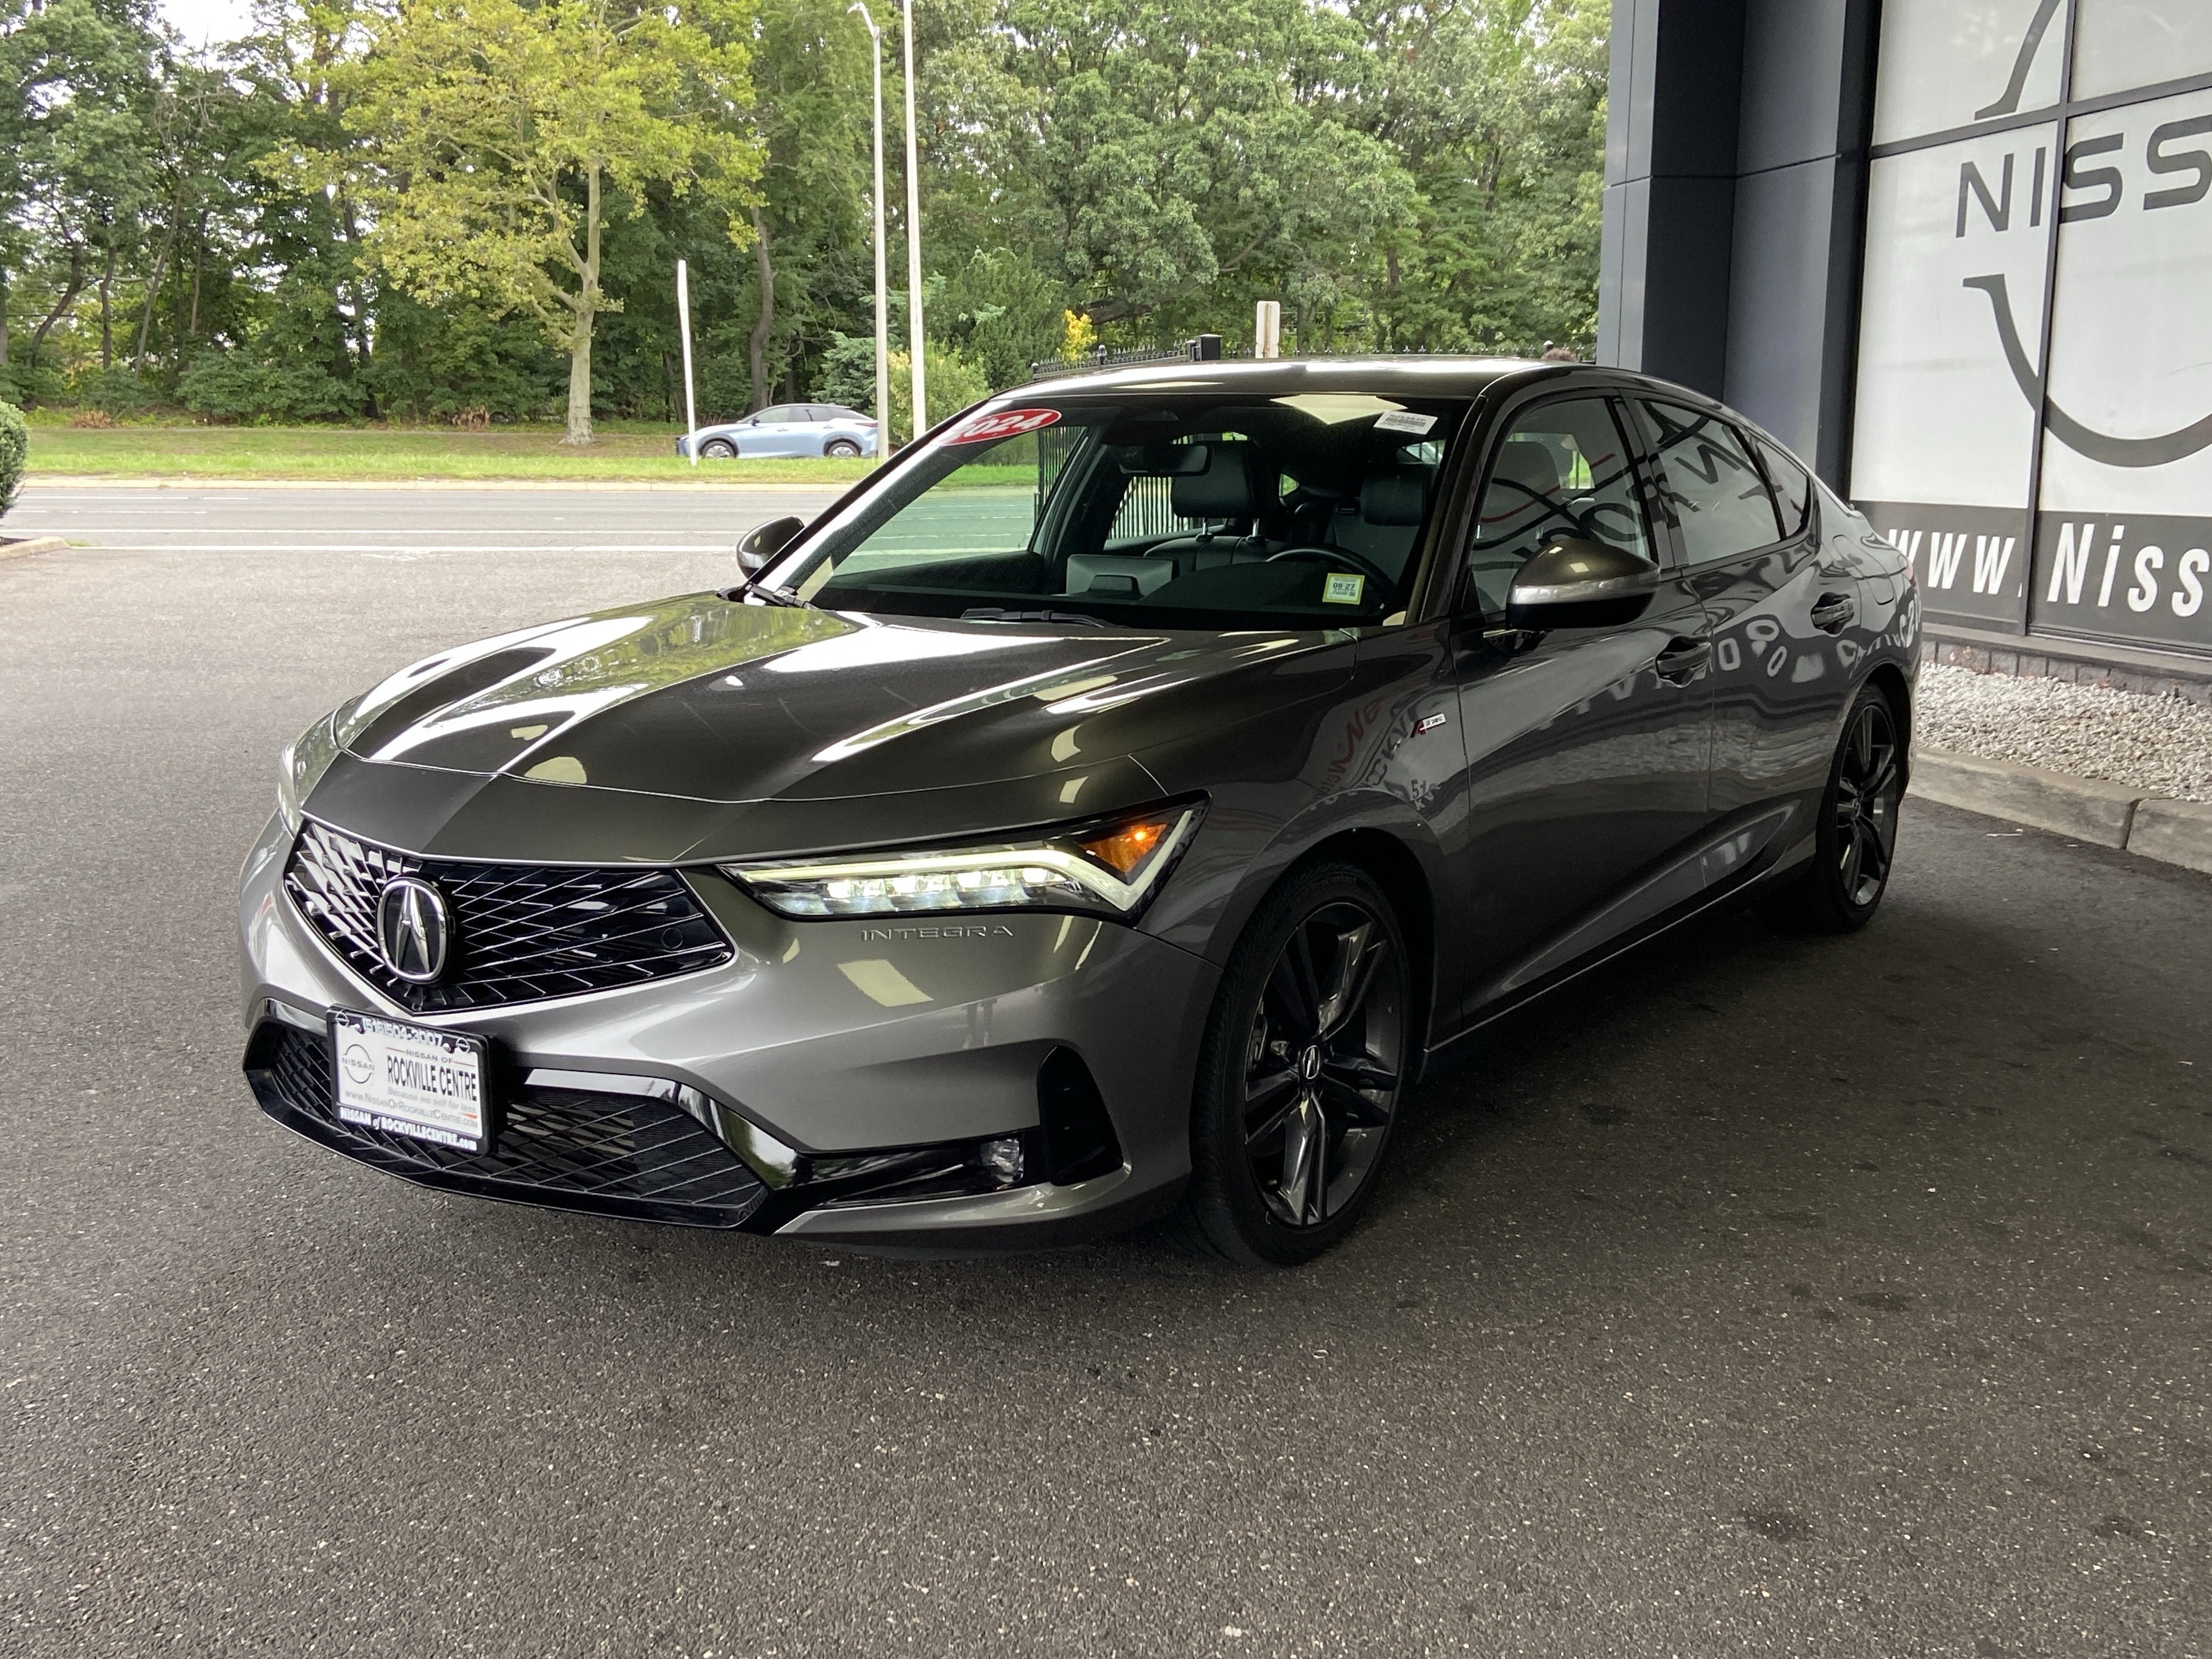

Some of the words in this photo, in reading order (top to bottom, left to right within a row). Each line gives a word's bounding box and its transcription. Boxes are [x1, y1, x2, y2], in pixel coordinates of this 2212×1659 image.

[1955, 115, 2212, 238] NISS
[862, 926, 1014, 941] INTEGRA
[342, 1057, 375, 1071] NISSAN
[406, 1049, 438, 1062] NISSAN
[387, 1055, 437, 1093] ROCKVILLE
[439, 1066, 477, 1102] CENTRE
[388, 1087, 418, 1101] Because
[433, 1098, 447, 1108] sell
[449, 1099, 459, 1110] for
[340, 1107, 371, 1126] NISSAN
[373, 1116, 381, 1130] of
